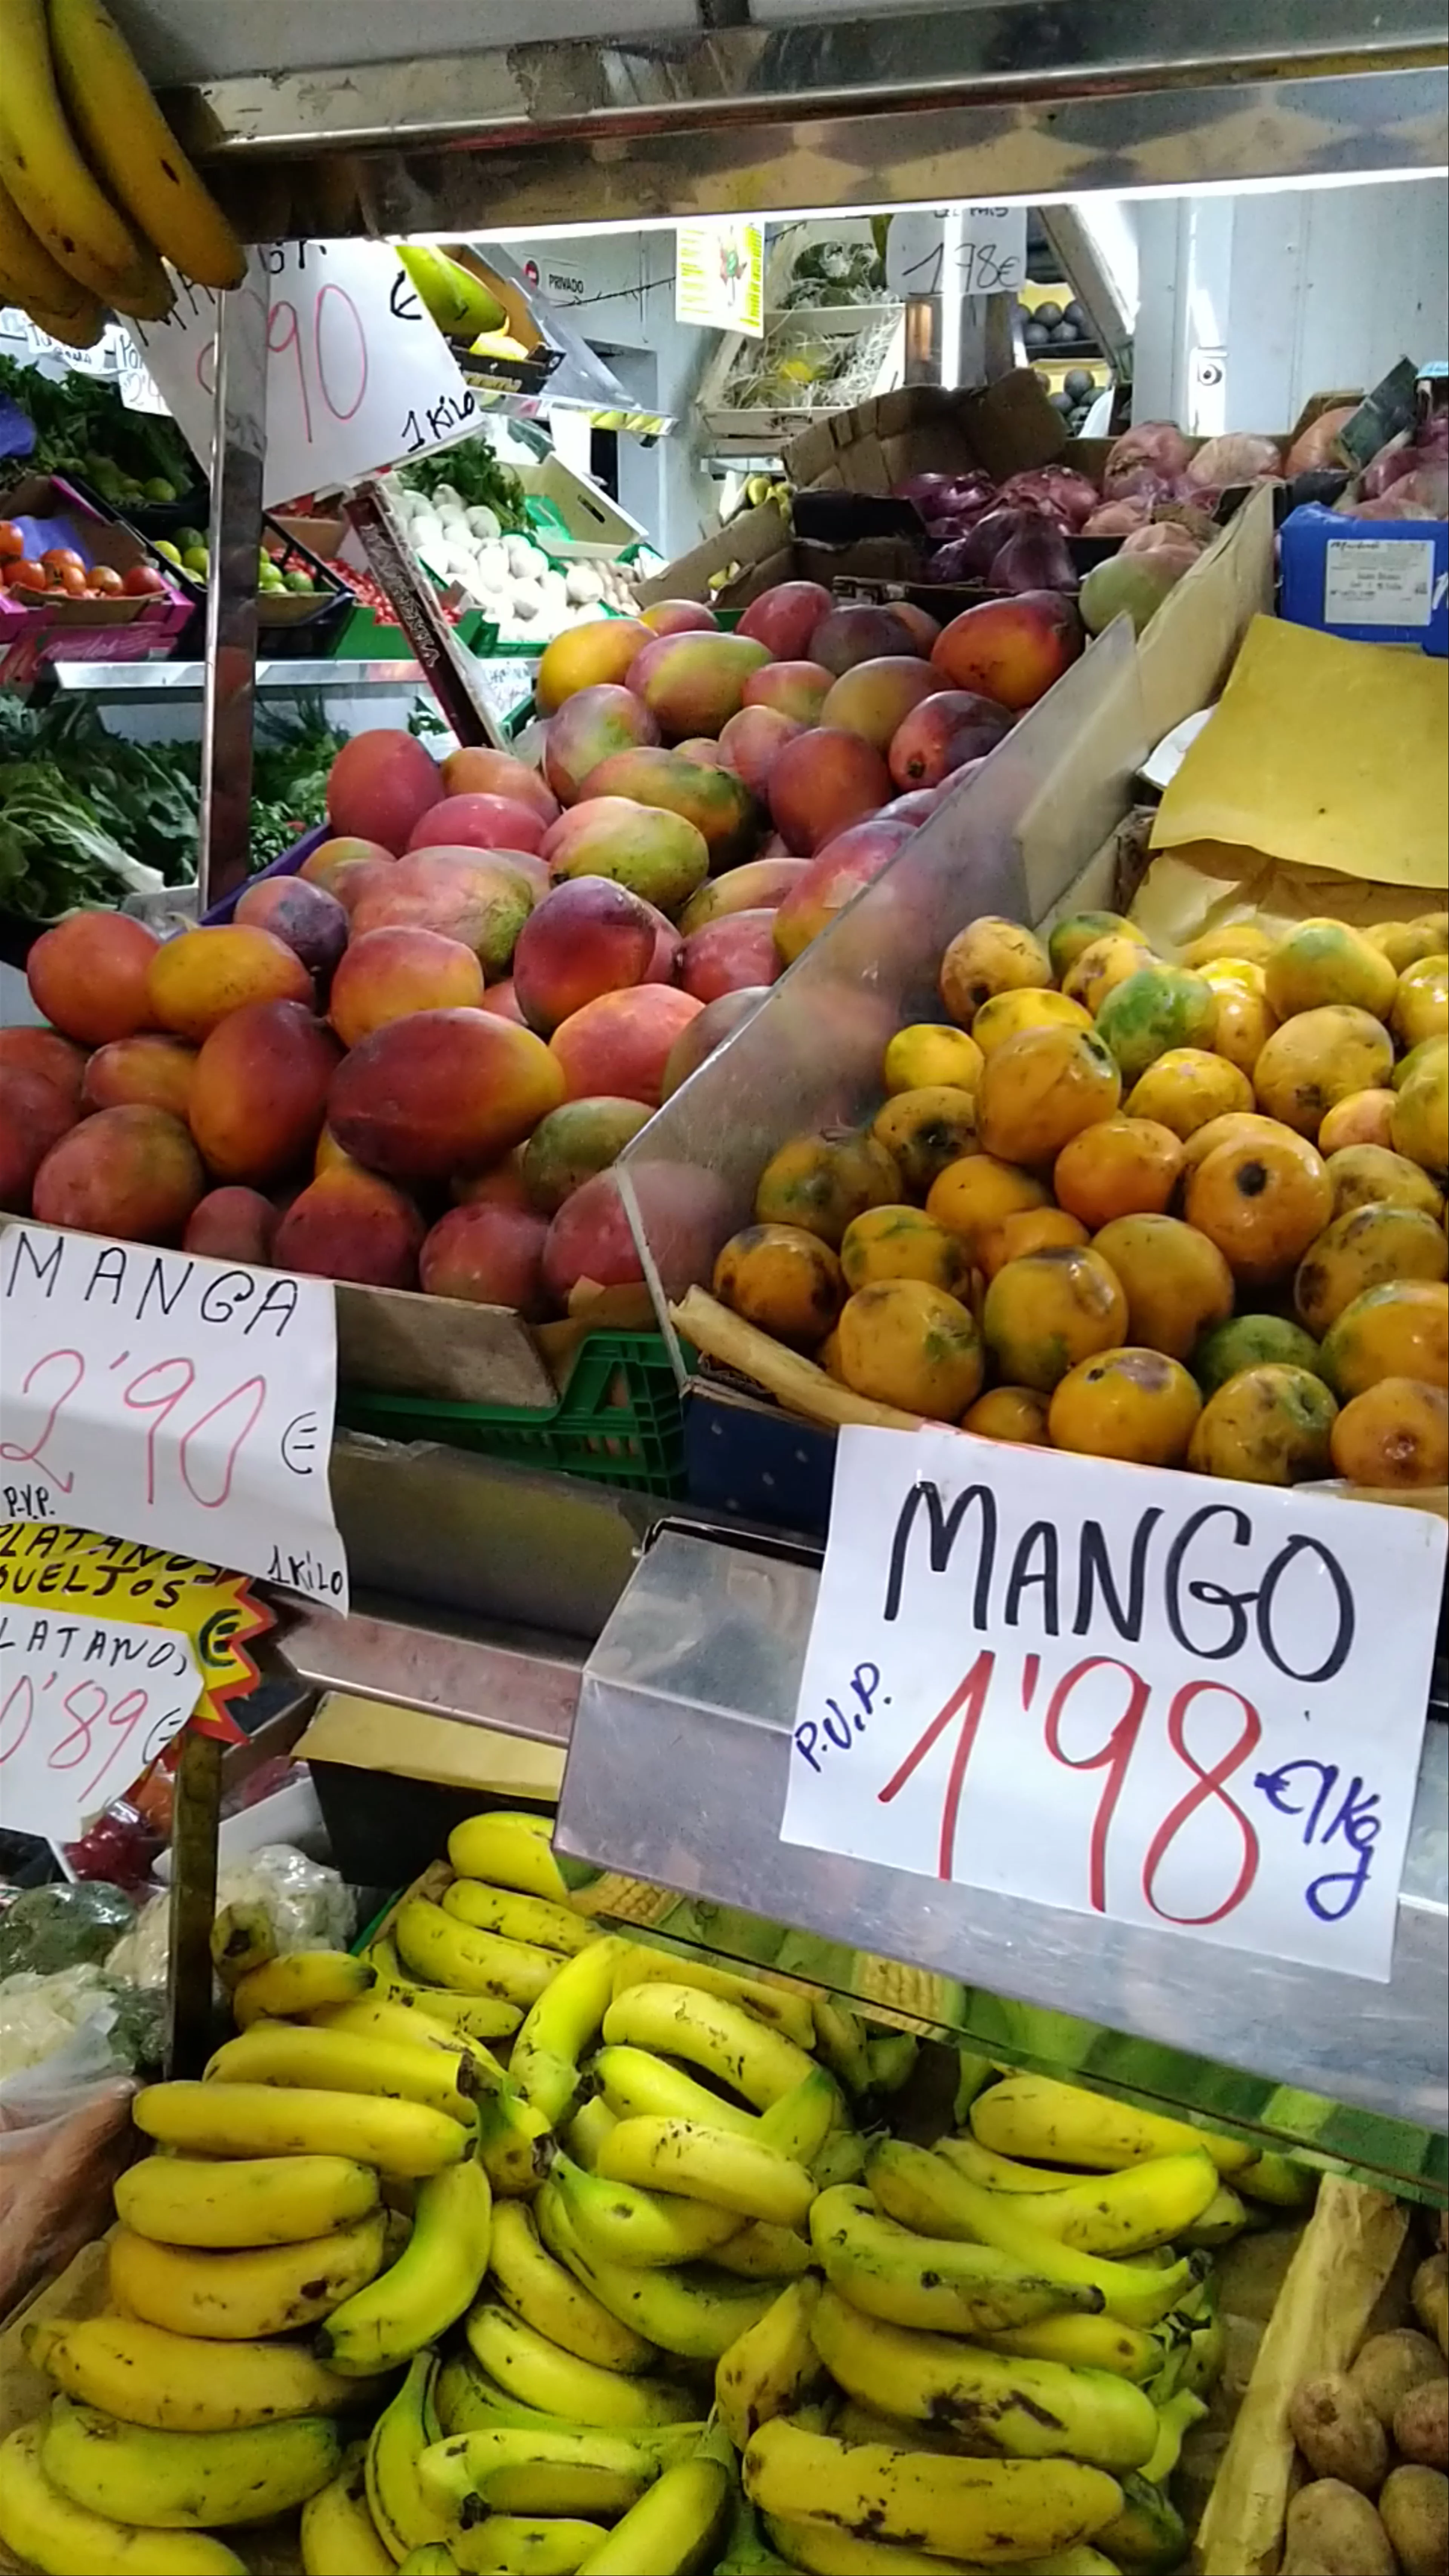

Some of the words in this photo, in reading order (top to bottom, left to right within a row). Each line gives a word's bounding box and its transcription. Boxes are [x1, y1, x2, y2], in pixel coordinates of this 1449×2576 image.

[549, 274, 584, 294] PRIVADO
[7, 1231, 298, 1337] MANGA
[0, 1349, 266, 1507] 2'90
[281, 1412, 317, 1474] €
[883, 1481, 1355, 1682] MANGO
[878, 1650, 1263, 1925] 1'98
